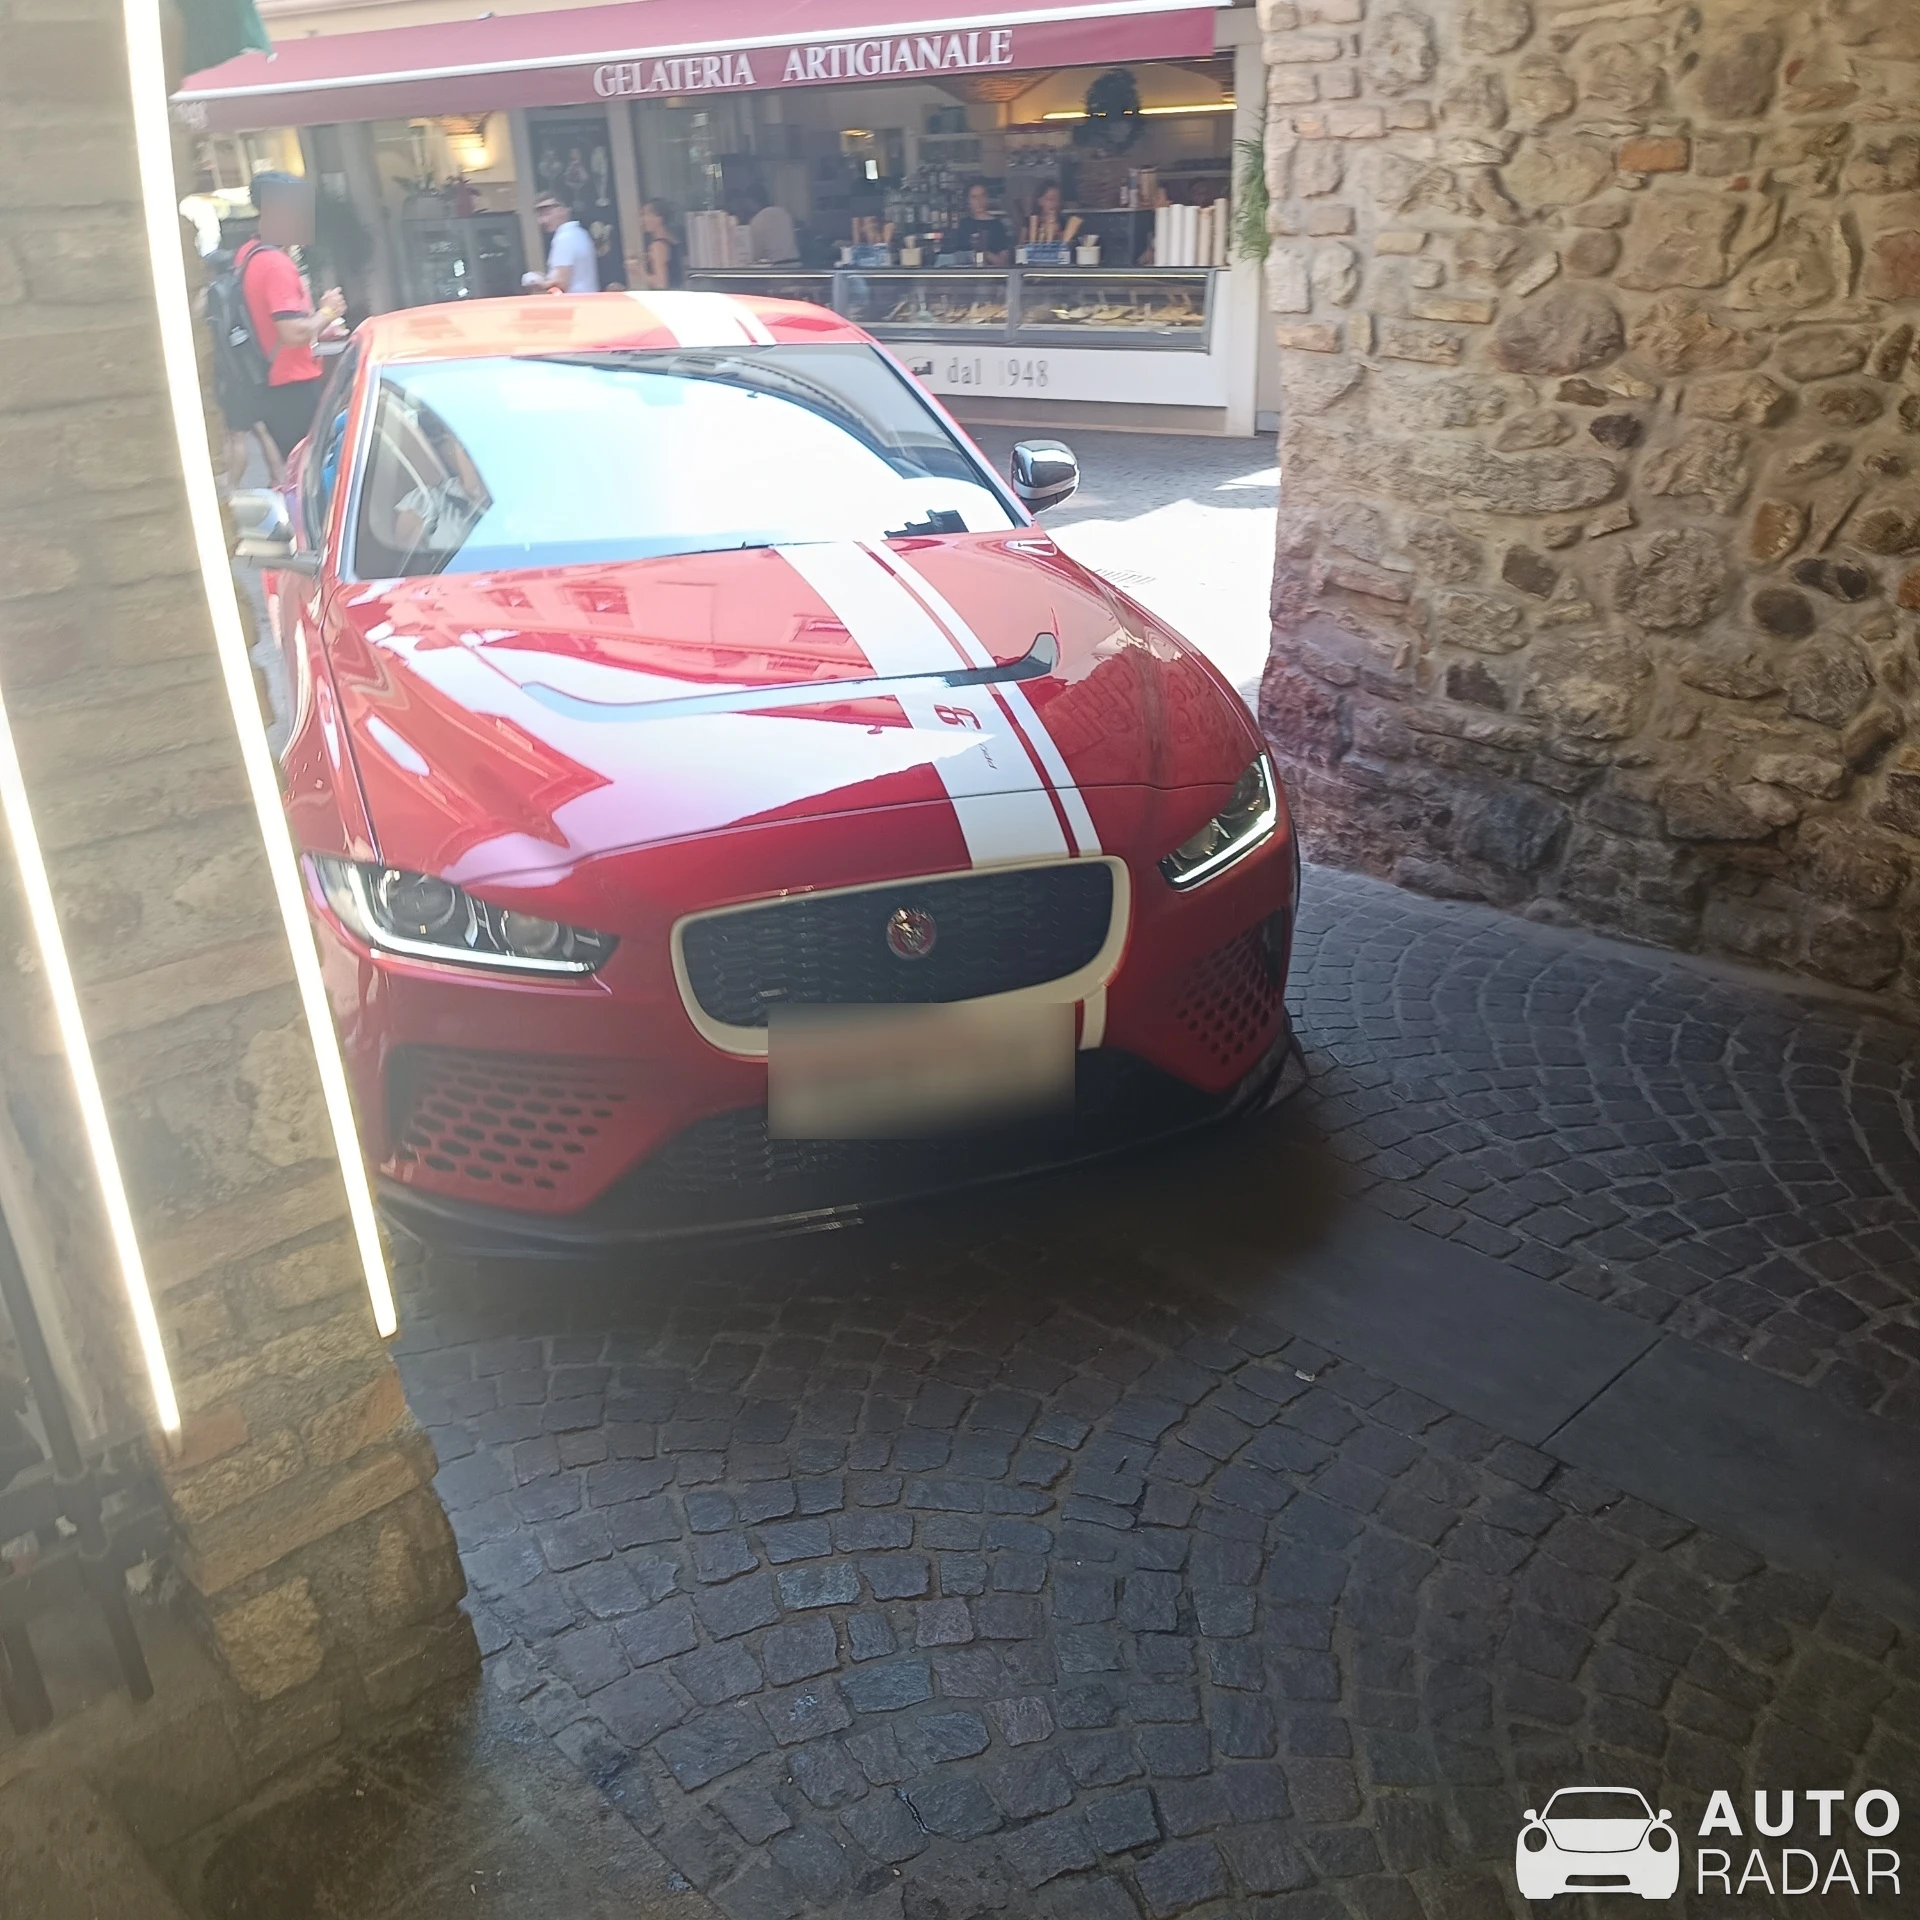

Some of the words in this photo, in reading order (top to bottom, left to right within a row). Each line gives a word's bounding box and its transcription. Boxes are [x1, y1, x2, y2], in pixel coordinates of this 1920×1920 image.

[593, 53, 757, 97] GELATERIA
[782, 29, 1014, 82] ARTIGIANALE
[947, 357, 982, 385] dal
[998, 358, 1049, 387] 1948
